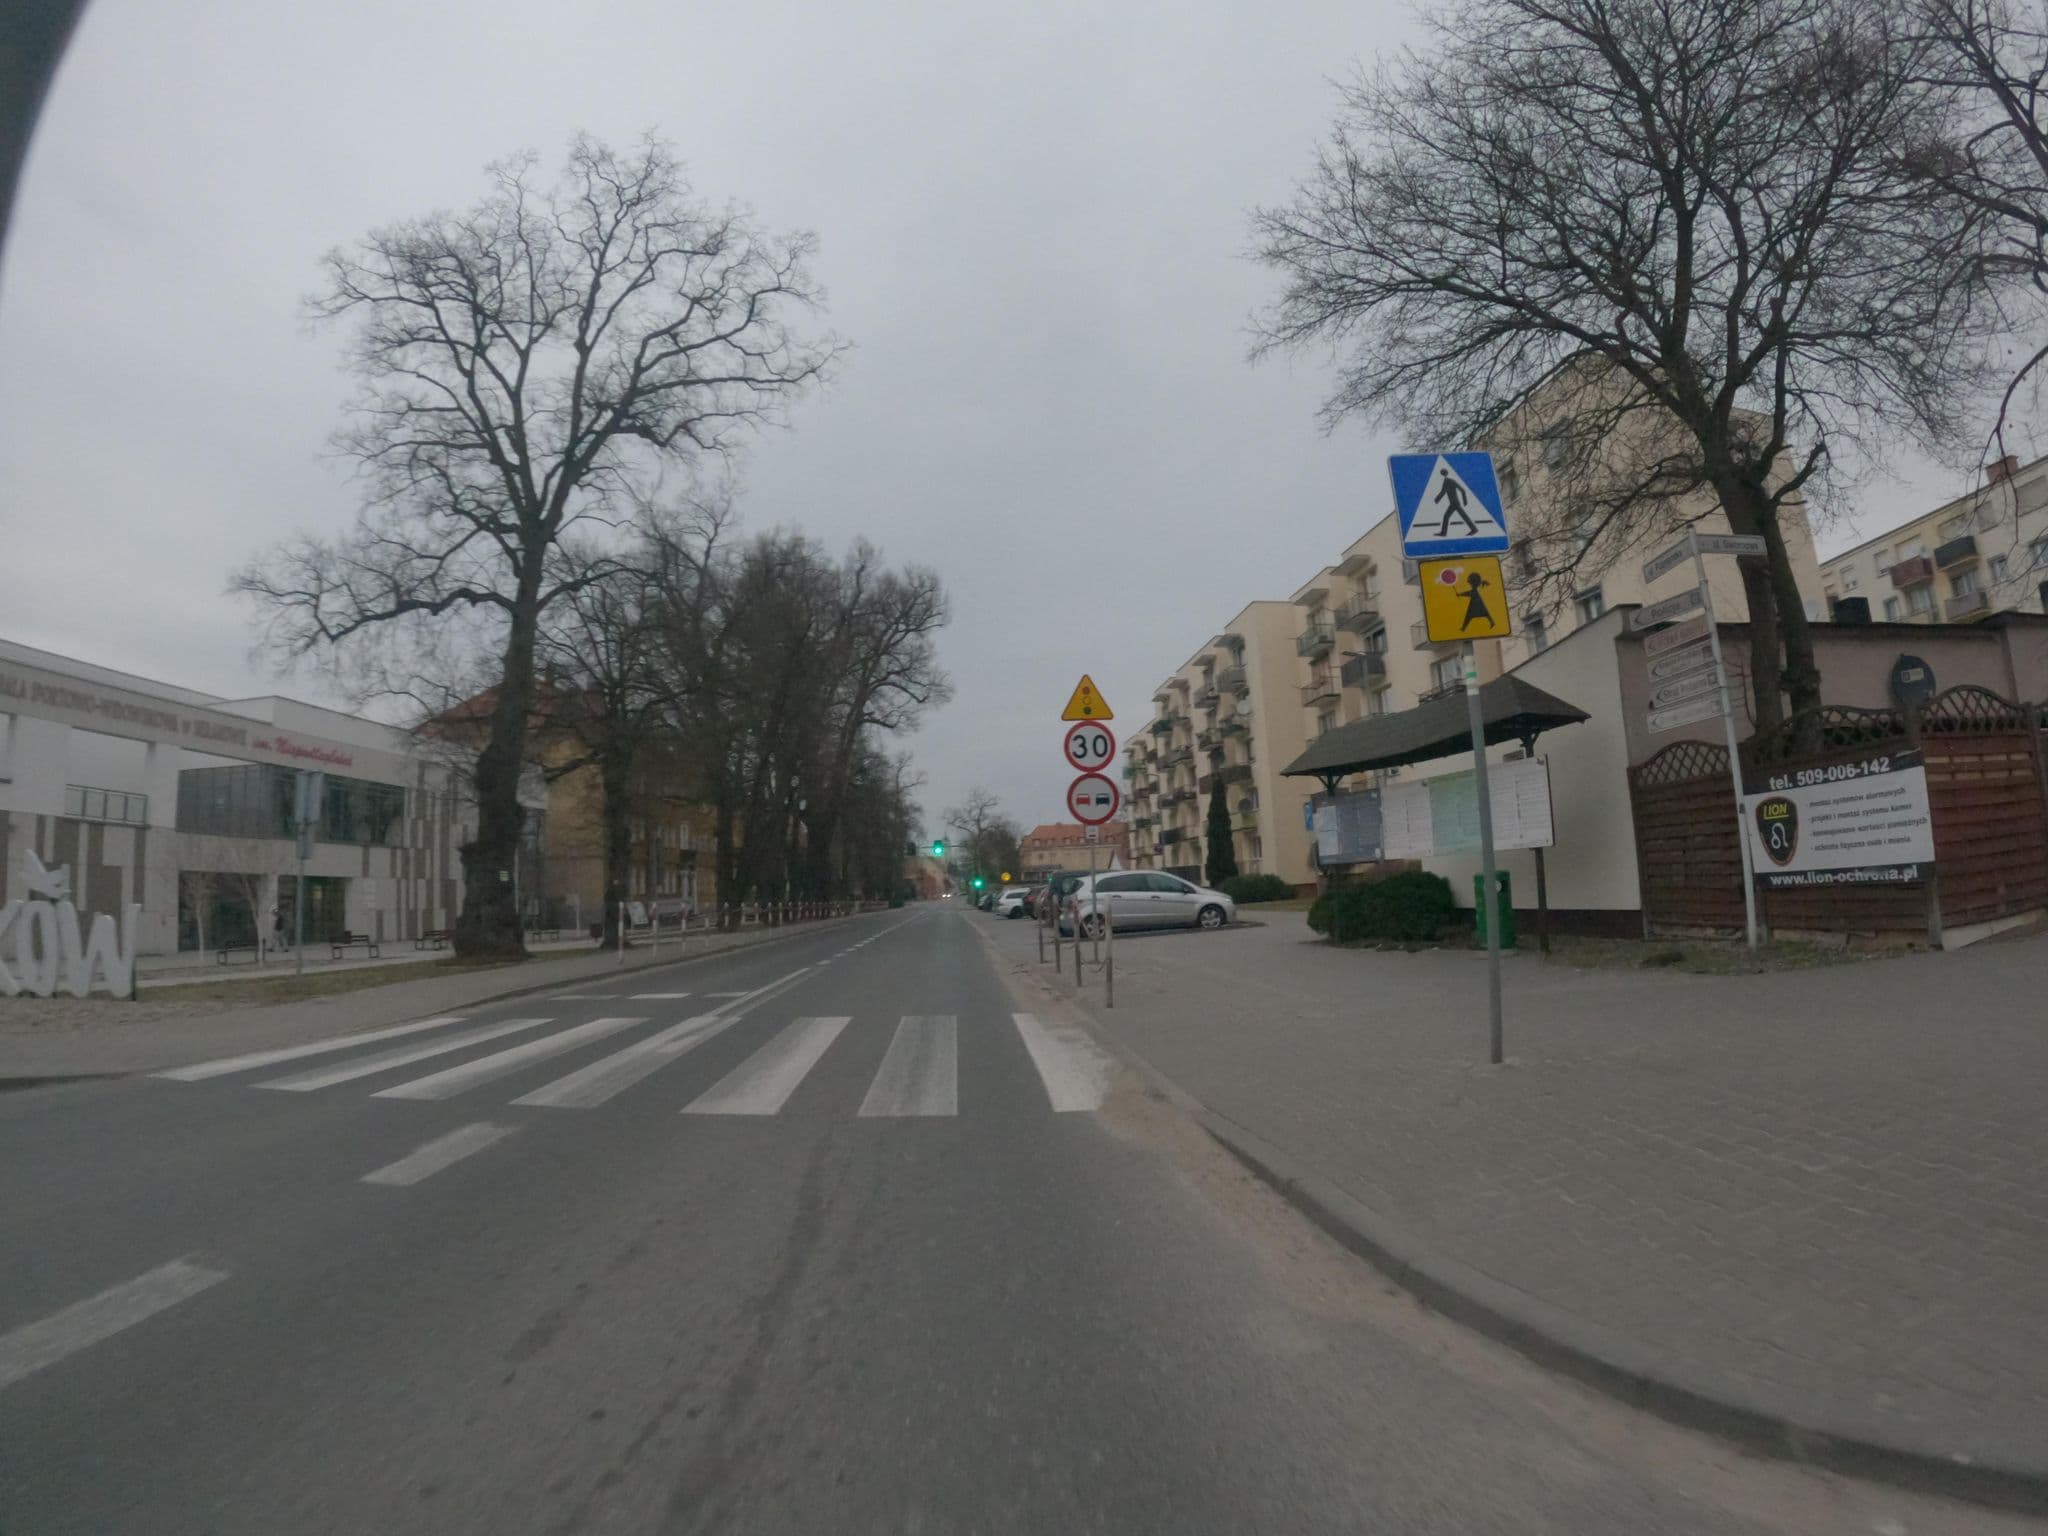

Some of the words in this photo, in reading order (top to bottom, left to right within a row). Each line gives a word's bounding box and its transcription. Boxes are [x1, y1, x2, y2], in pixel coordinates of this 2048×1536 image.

[1072, 734, 1108, 759] 30
[1769, 774, 1793, 791] tel.
[1796, 756, 1890, 785] 509-006-142
[1763, 803, 1789, 820] LION
